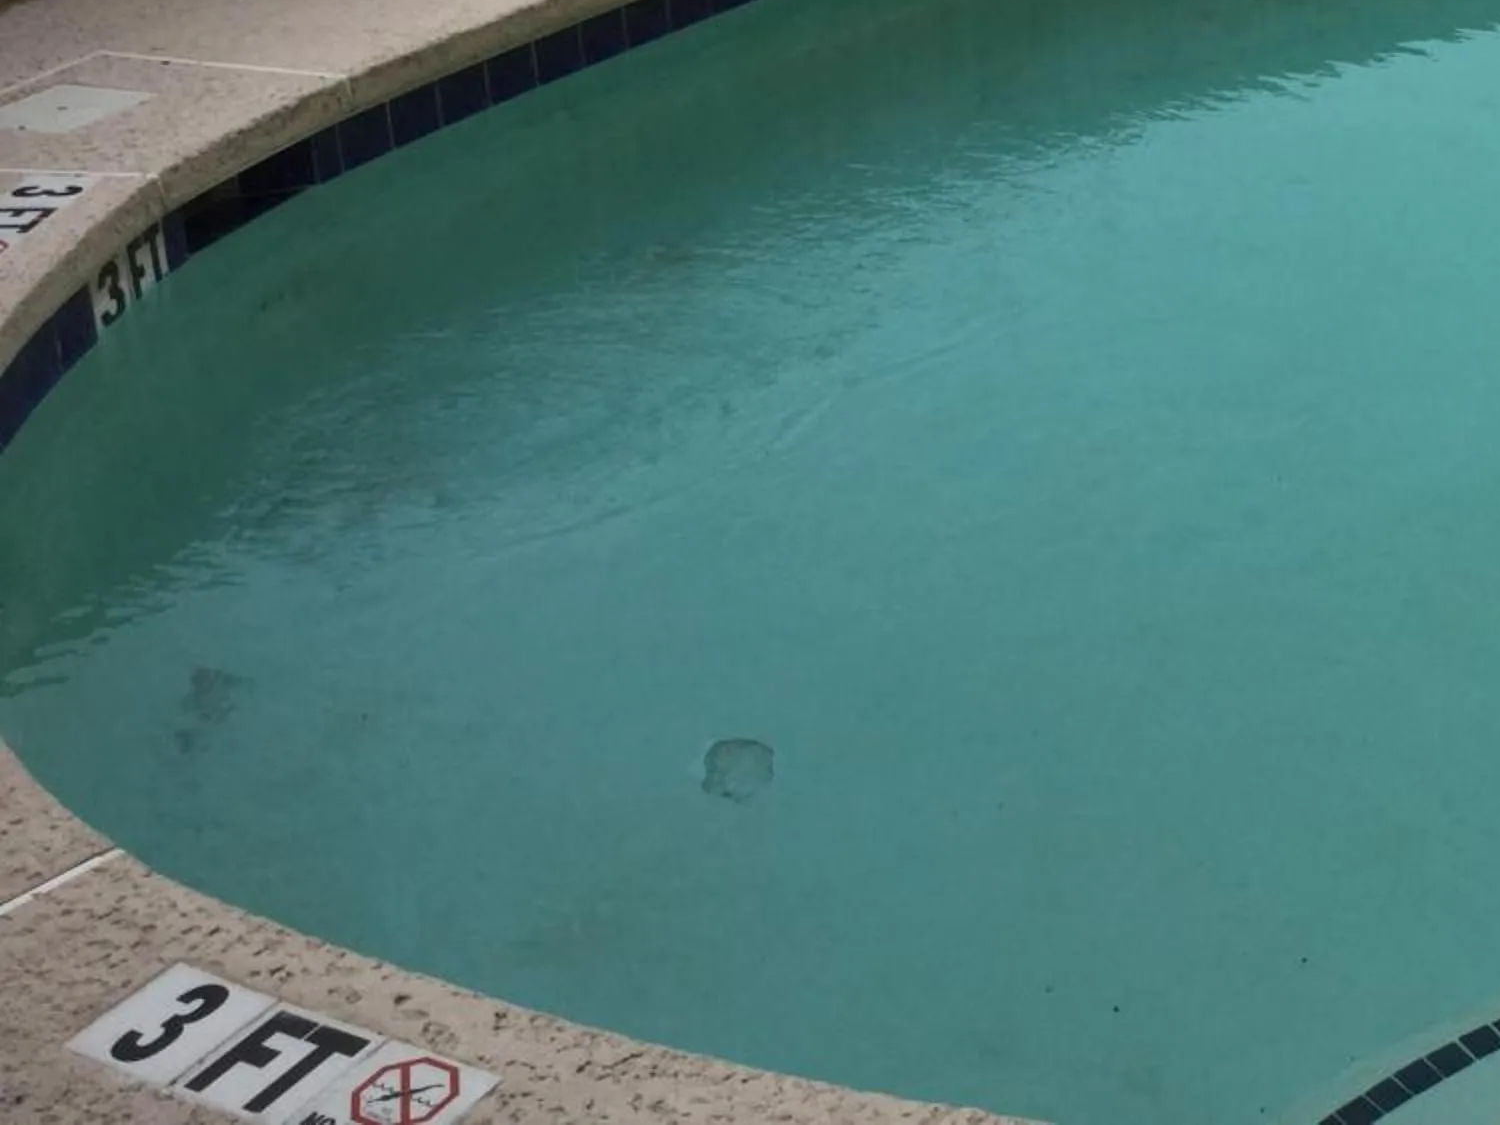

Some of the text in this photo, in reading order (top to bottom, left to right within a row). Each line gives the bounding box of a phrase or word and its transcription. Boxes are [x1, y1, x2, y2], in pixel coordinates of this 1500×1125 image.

[12, 185, 83, 198] 3
[98, 222, 164, 327] 3 FT
[110, 983, 371, 1113] 3 FT
